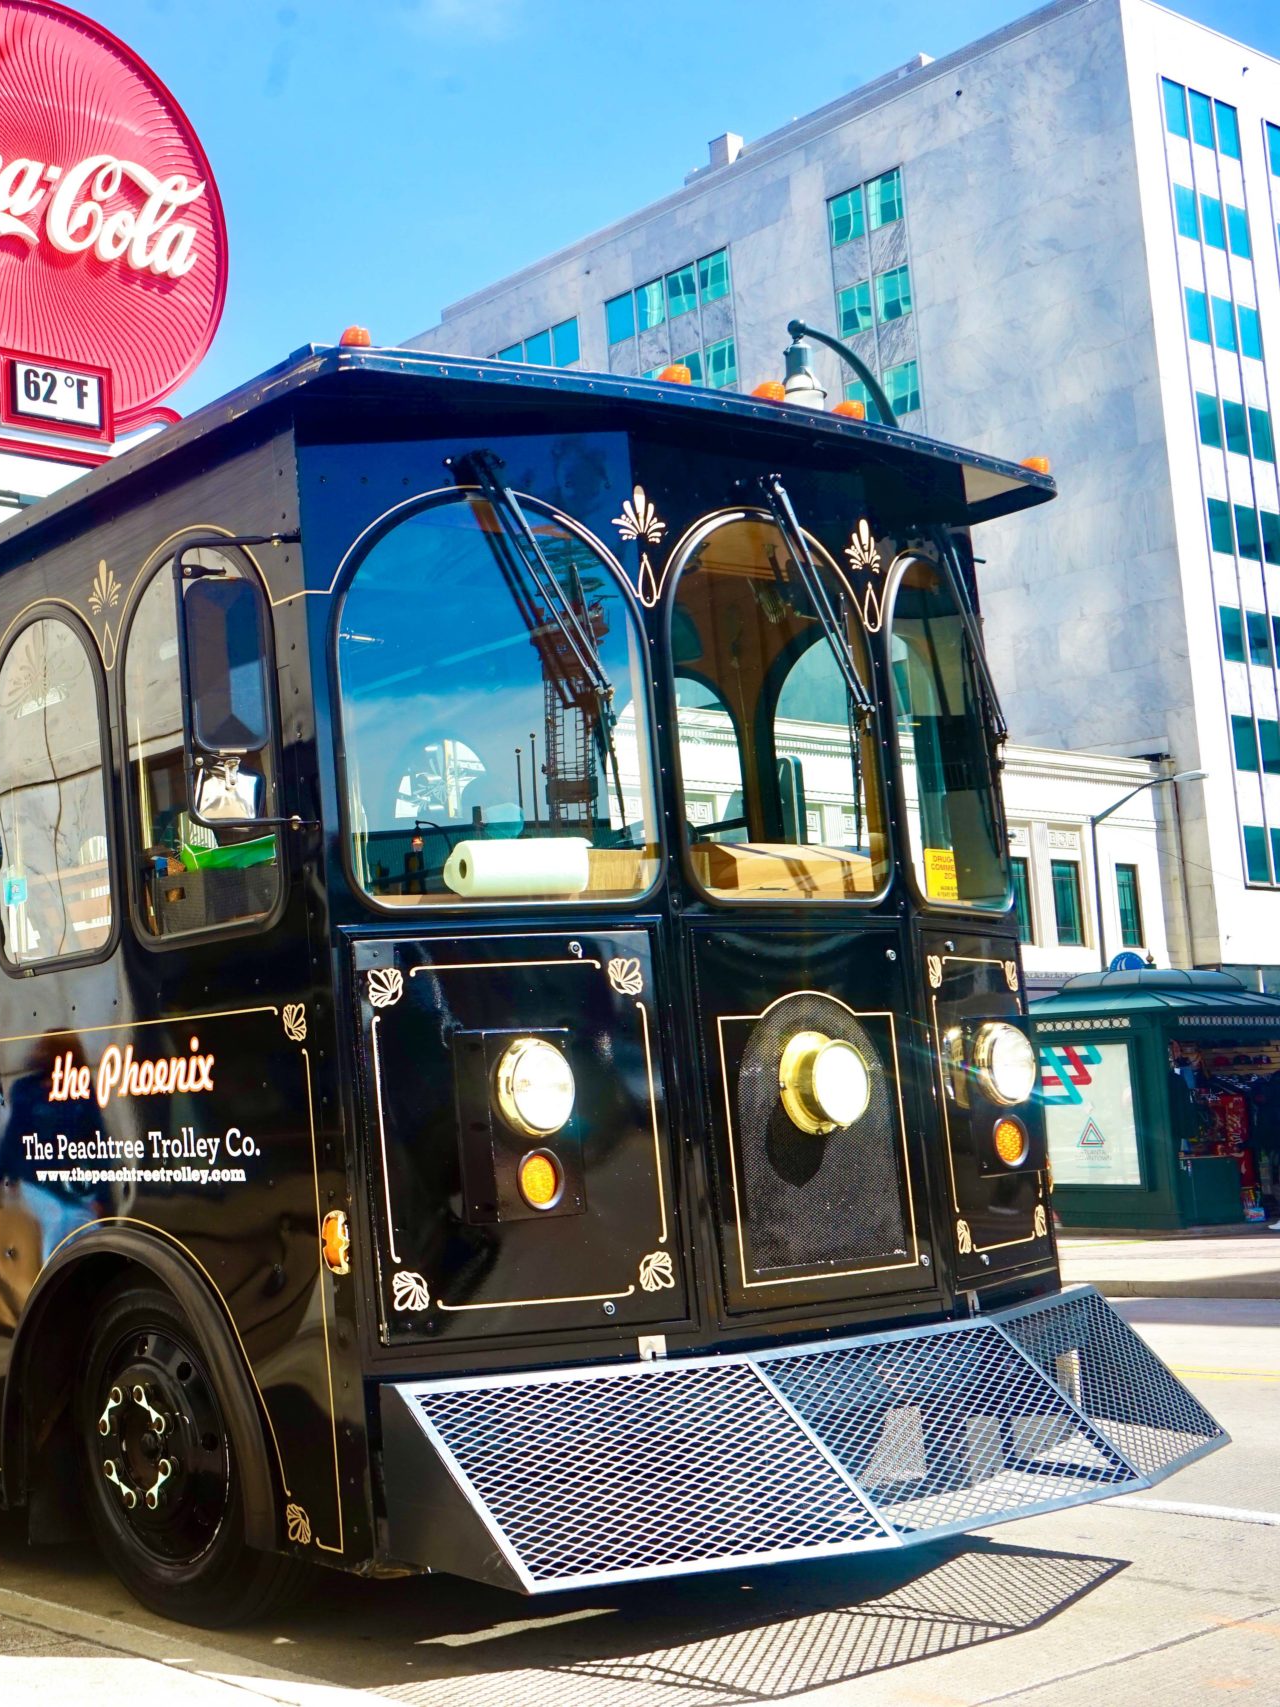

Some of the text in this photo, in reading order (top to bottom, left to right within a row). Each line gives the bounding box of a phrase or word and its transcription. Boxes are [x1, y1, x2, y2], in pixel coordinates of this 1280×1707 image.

[23, 368, 58, 405] 62
[48, 1035, 215, 1109] the Phoenix
[22, 1126, 262, 1166] The Peachtree Trolley Co.
[35, 1166, 247, 1185] www.thepeachtreetrolley.com
